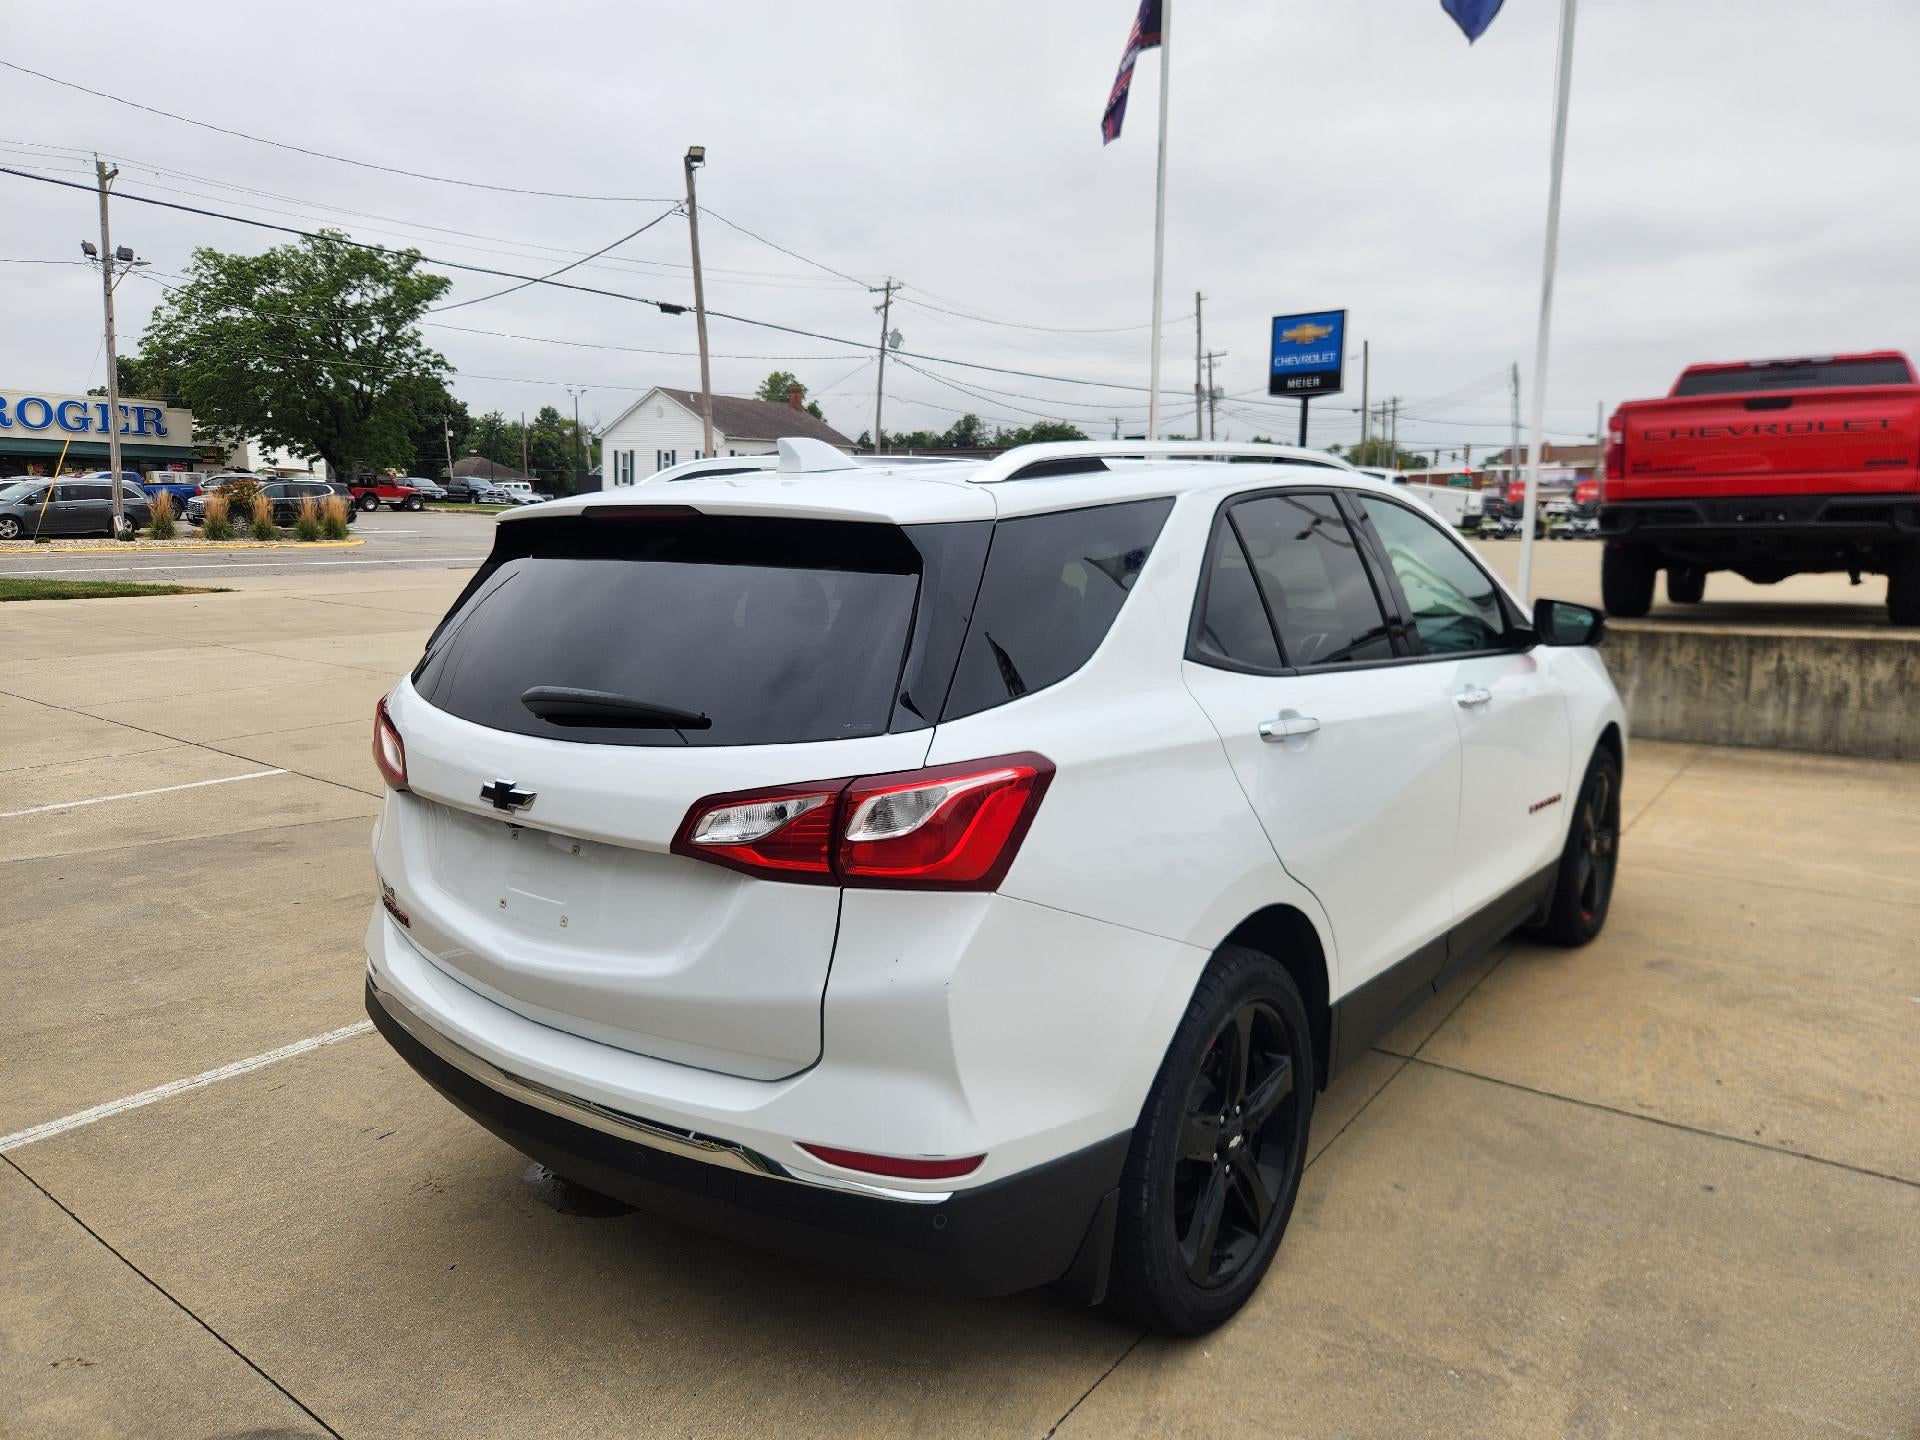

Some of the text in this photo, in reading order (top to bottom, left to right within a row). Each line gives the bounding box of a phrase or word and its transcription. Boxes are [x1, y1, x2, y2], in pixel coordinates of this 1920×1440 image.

[1274, 351, 1336, 367] CHEVROLET
[1286, 376, 1320, 389] MEIER
[1643, 418, 1896, 442] CHEVROLET
